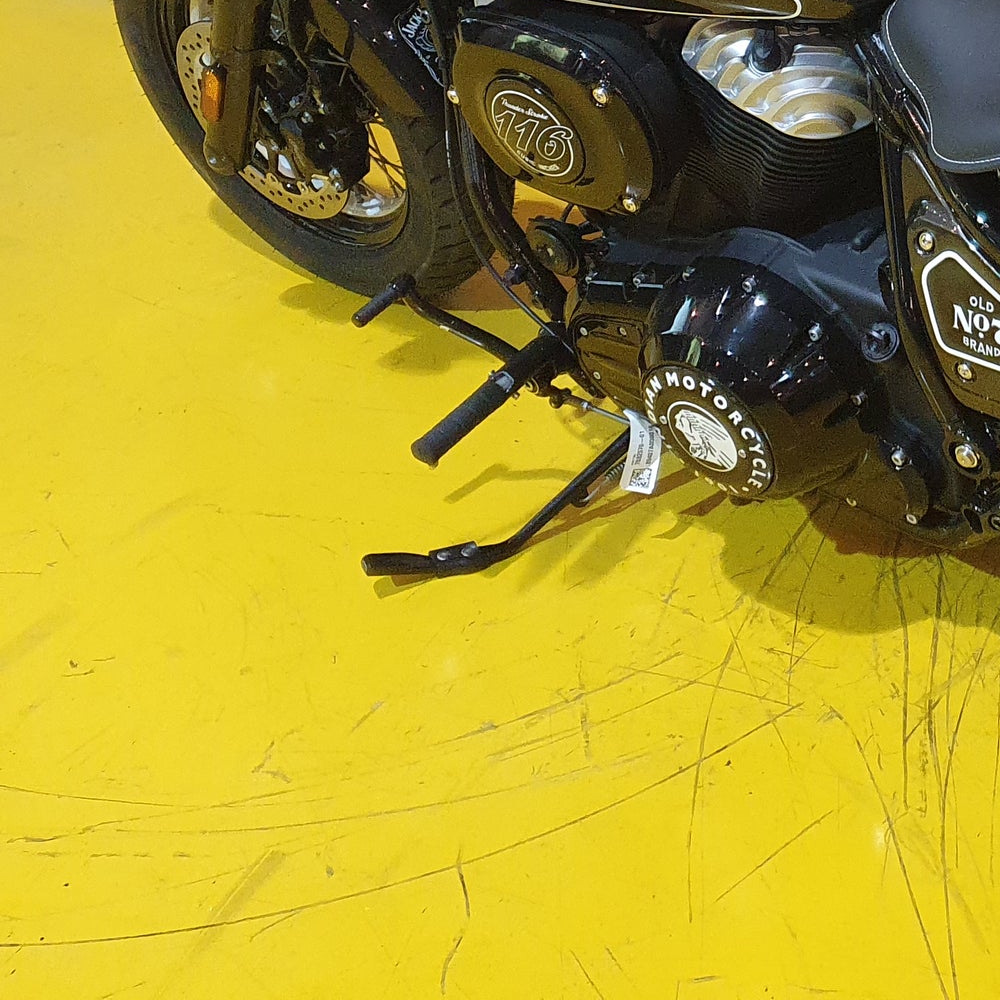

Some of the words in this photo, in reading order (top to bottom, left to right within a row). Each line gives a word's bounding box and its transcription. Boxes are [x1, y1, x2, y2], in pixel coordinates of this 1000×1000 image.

[494, 110, 574, 161] 116
[969, 296, 994, 313] OLD
[962, 336, 1000, 357] BRAND
[644, 375, 663, 424] DIAN
[665, 371, 771, 489] MOTORCYCLE
